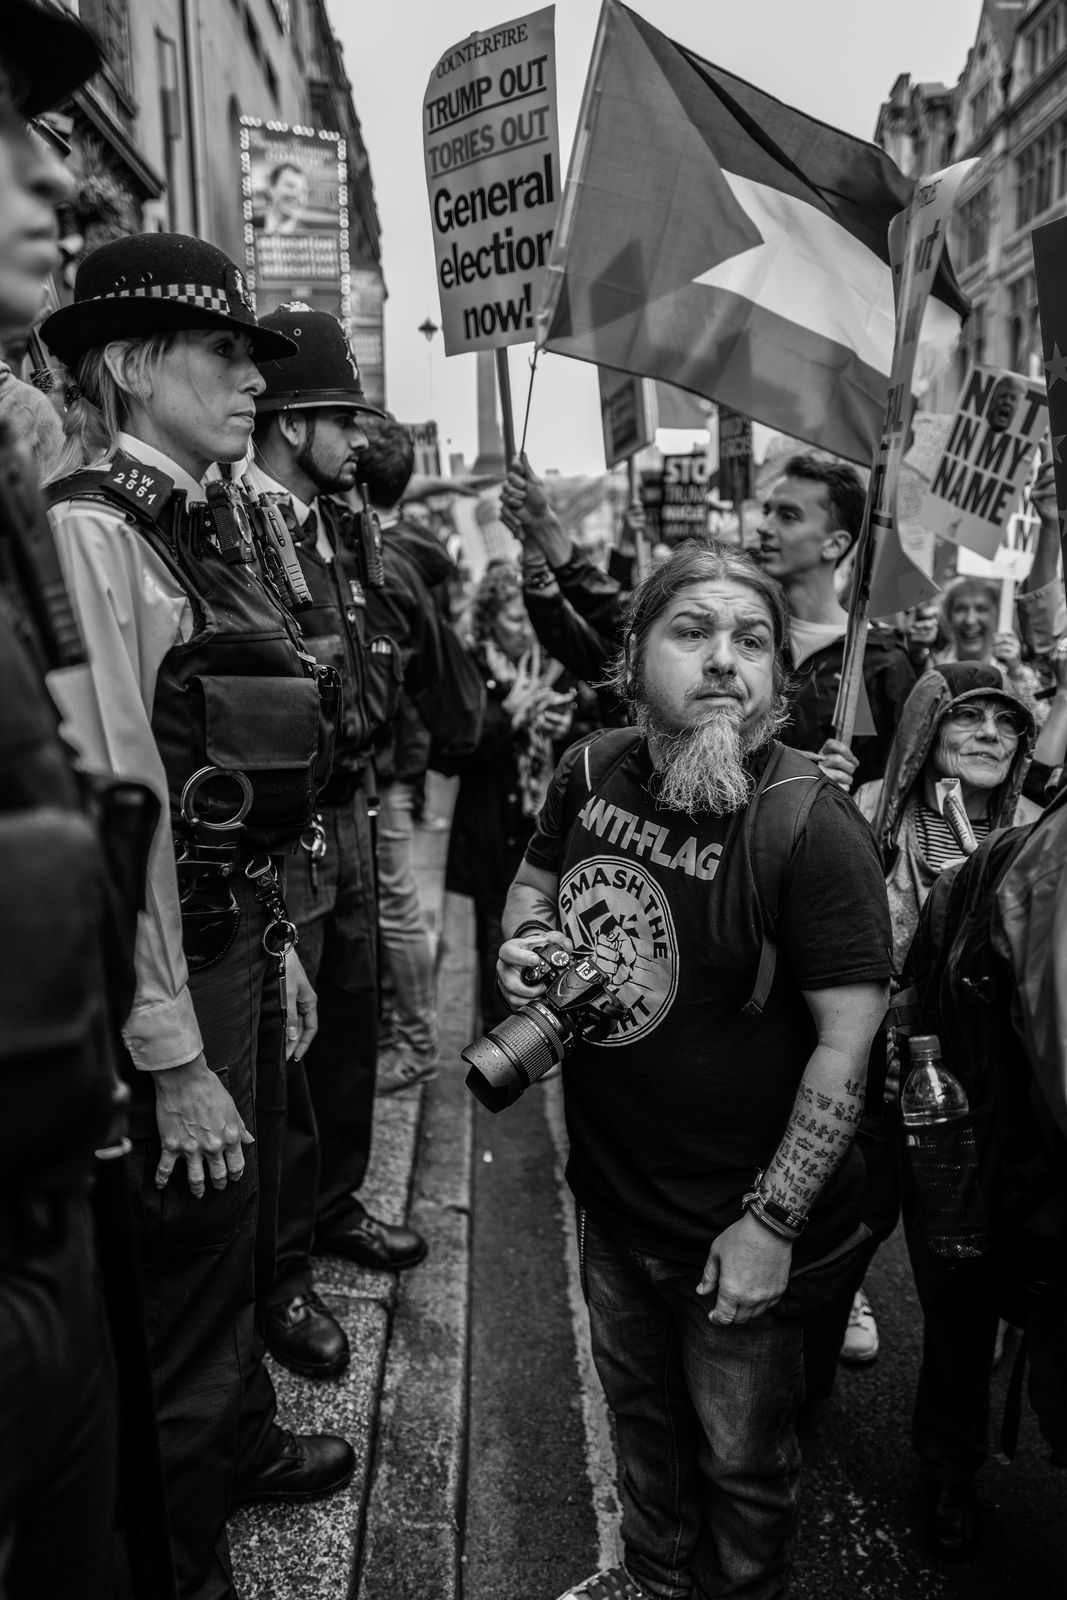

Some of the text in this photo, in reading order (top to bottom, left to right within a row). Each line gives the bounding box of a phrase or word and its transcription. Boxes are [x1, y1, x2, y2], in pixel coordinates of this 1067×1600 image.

[436, 24, 528, 79] COUNTERFIRE
[426, 55, 548, 129] TRUMP OUT
[429, 105, 549, 174] TORIES OUT
[434, 154, 554, 234] General
[440, 227, 554, 289] election
[463, 283, 534, 340] now!
[961, 370, 1049, 435] NT
[129, 469, 155, 487] SW
[664, 456, 710, 484] STO
[946, 413, 1033, 480] IN MY
[113, 472, 157, 505] 2551
[931, 453, 1016, 526] NAME
[577, 795, 724, 880] ANTI-FLAG
[560, 867, 668, 959] SMASH THE
